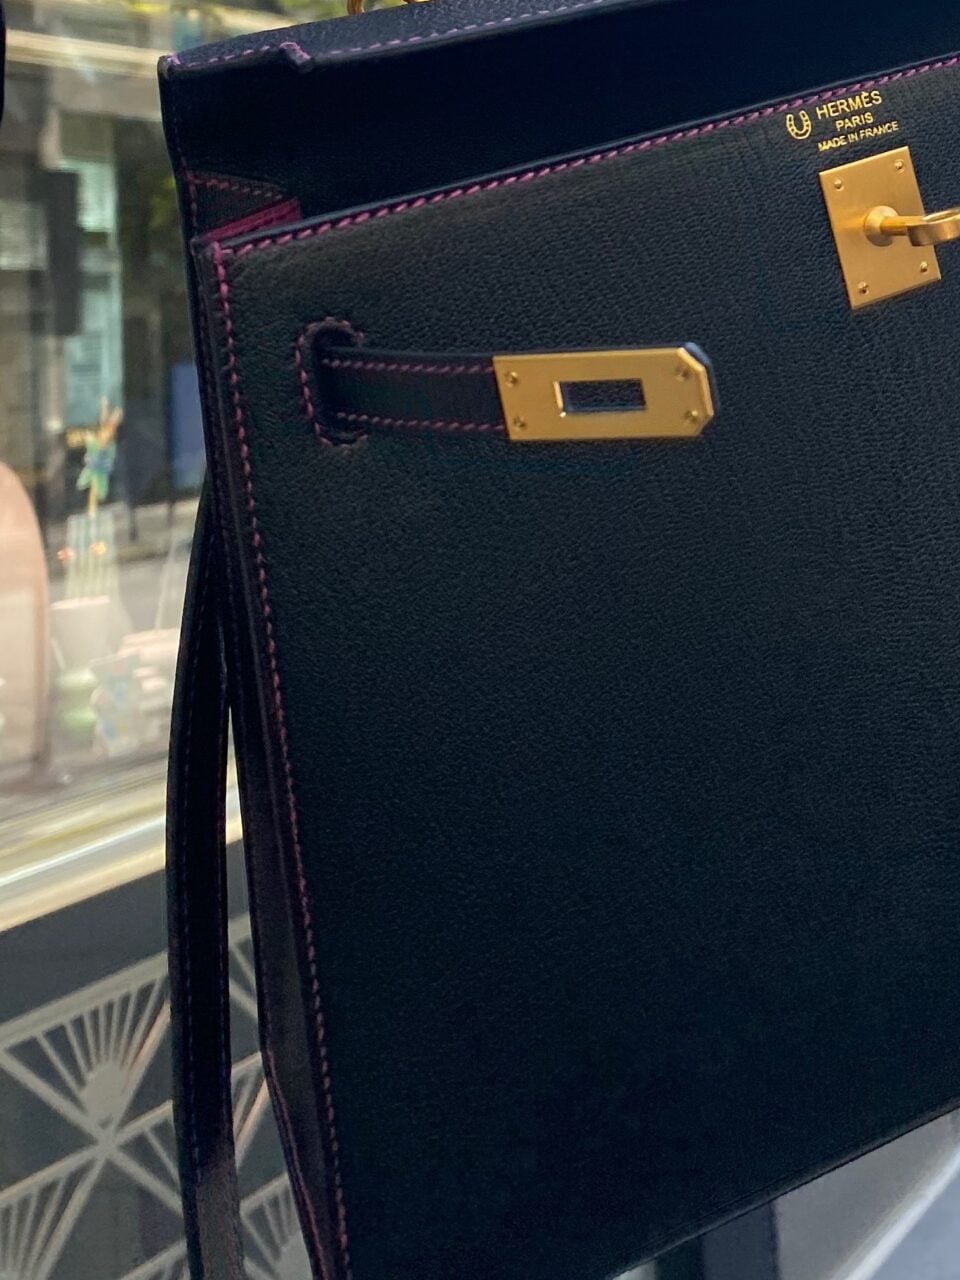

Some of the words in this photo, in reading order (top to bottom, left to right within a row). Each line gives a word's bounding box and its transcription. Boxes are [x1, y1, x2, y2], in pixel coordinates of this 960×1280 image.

[815, 90, 882, 120] HERMÈS
[817, 135, 848, 152] MADE
[848, 132, 859, 144] IN
[859, 121, 899, 141] FRANCE
[835, 112, 874, 132] PARIS
